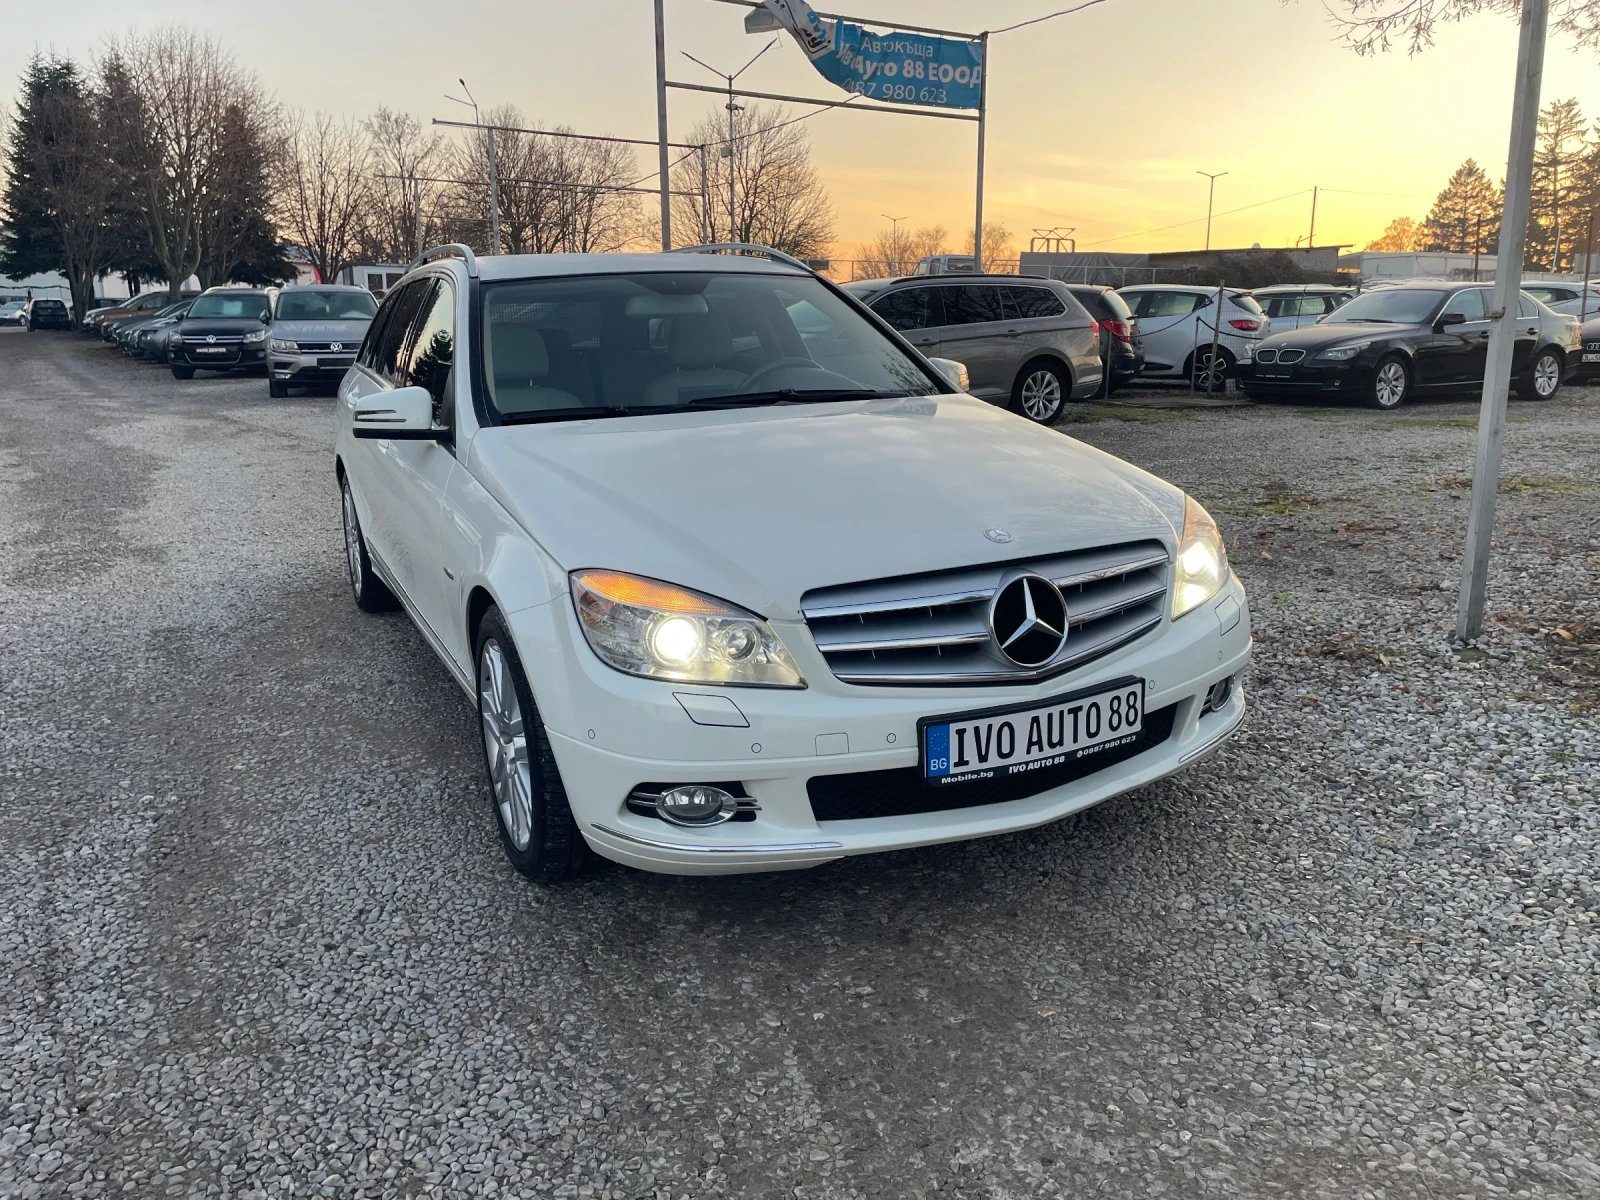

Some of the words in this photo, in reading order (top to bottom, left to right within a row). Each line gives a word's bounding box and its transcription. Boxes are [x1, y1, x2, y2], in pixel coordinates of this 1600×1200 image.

[861, 37, 933, 59] Автокъща
[855, 55, 898, 80] Ауто
[903, 59, 925, 79] 88
[929, 62, 981, 88] ЕООД
[882, 83, 916, 100] 980
[920, 86, 947, 104] 623
[953, 721, 1016, 768] IVO
[1026, 701, 1101, 755] AUTO
[1108, 690, 1139, 732] 88
[1083, 744, 1104, 755] 0887
[1104, 739, 1120, 749] 980
[1121, 735, 1136, 744] 623
[930, 758, 948, 771] BG
[1008, 764, 1026, 774] IVO
[1027, 758, 1053, 771] AUTO
[1053, 755, 1066, 764] 88
[941, 771, 994, 784] Mobile.bg
